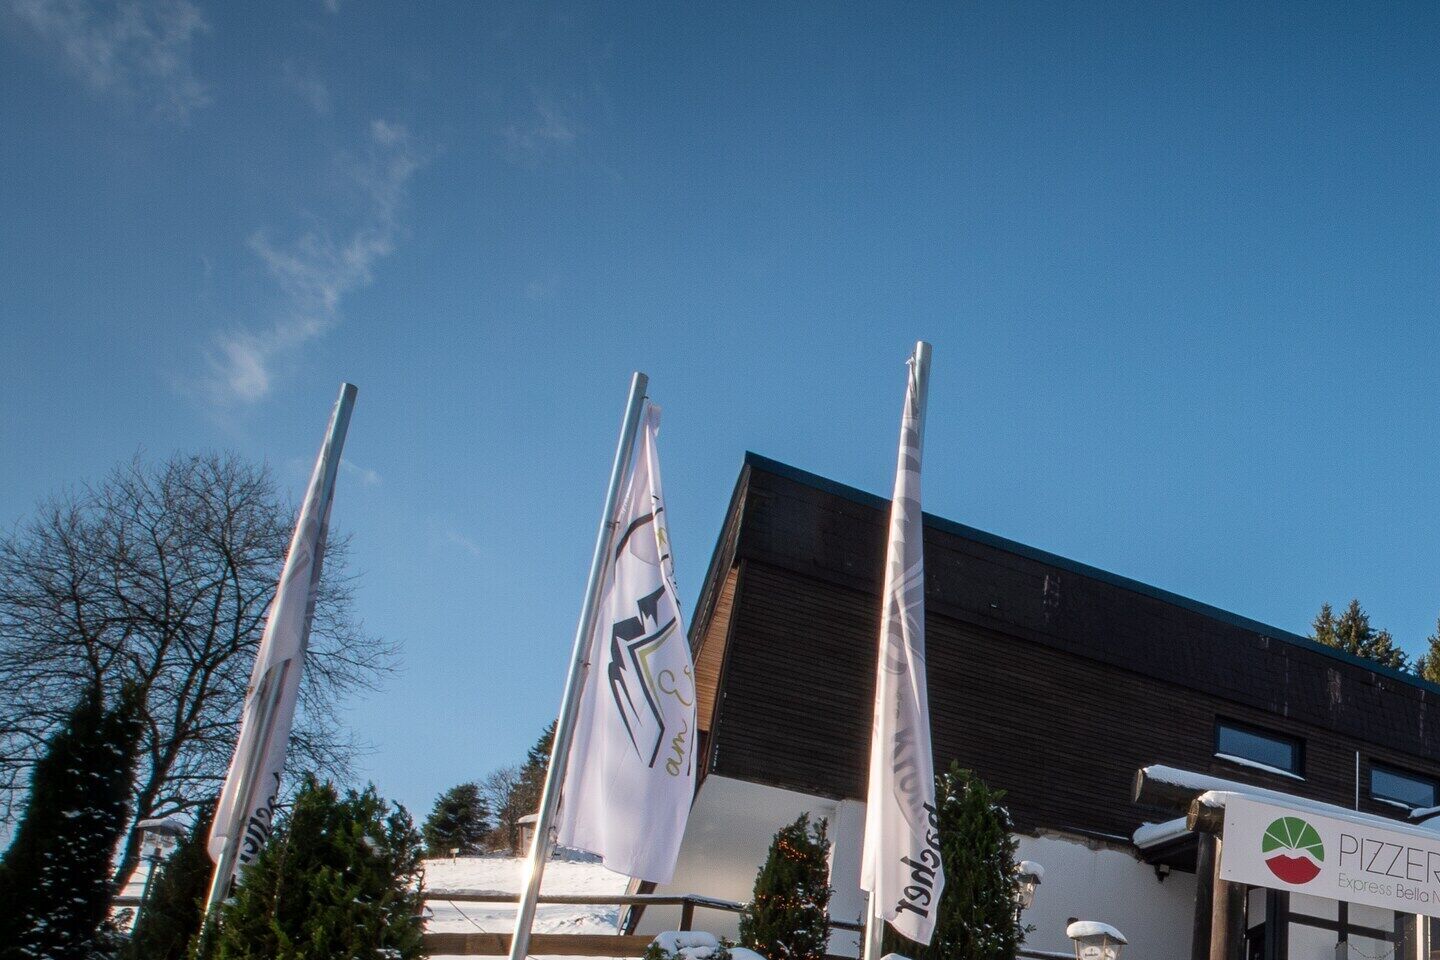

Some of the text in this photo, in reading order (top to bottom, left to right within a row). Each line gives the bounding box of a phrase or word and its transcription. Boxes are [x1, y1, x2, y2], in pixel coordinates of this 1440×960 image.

[666, 718, 688, 777] am
[1338, 872, 1392, 896] Express
[1396, 883, 1429, 903] Bella
